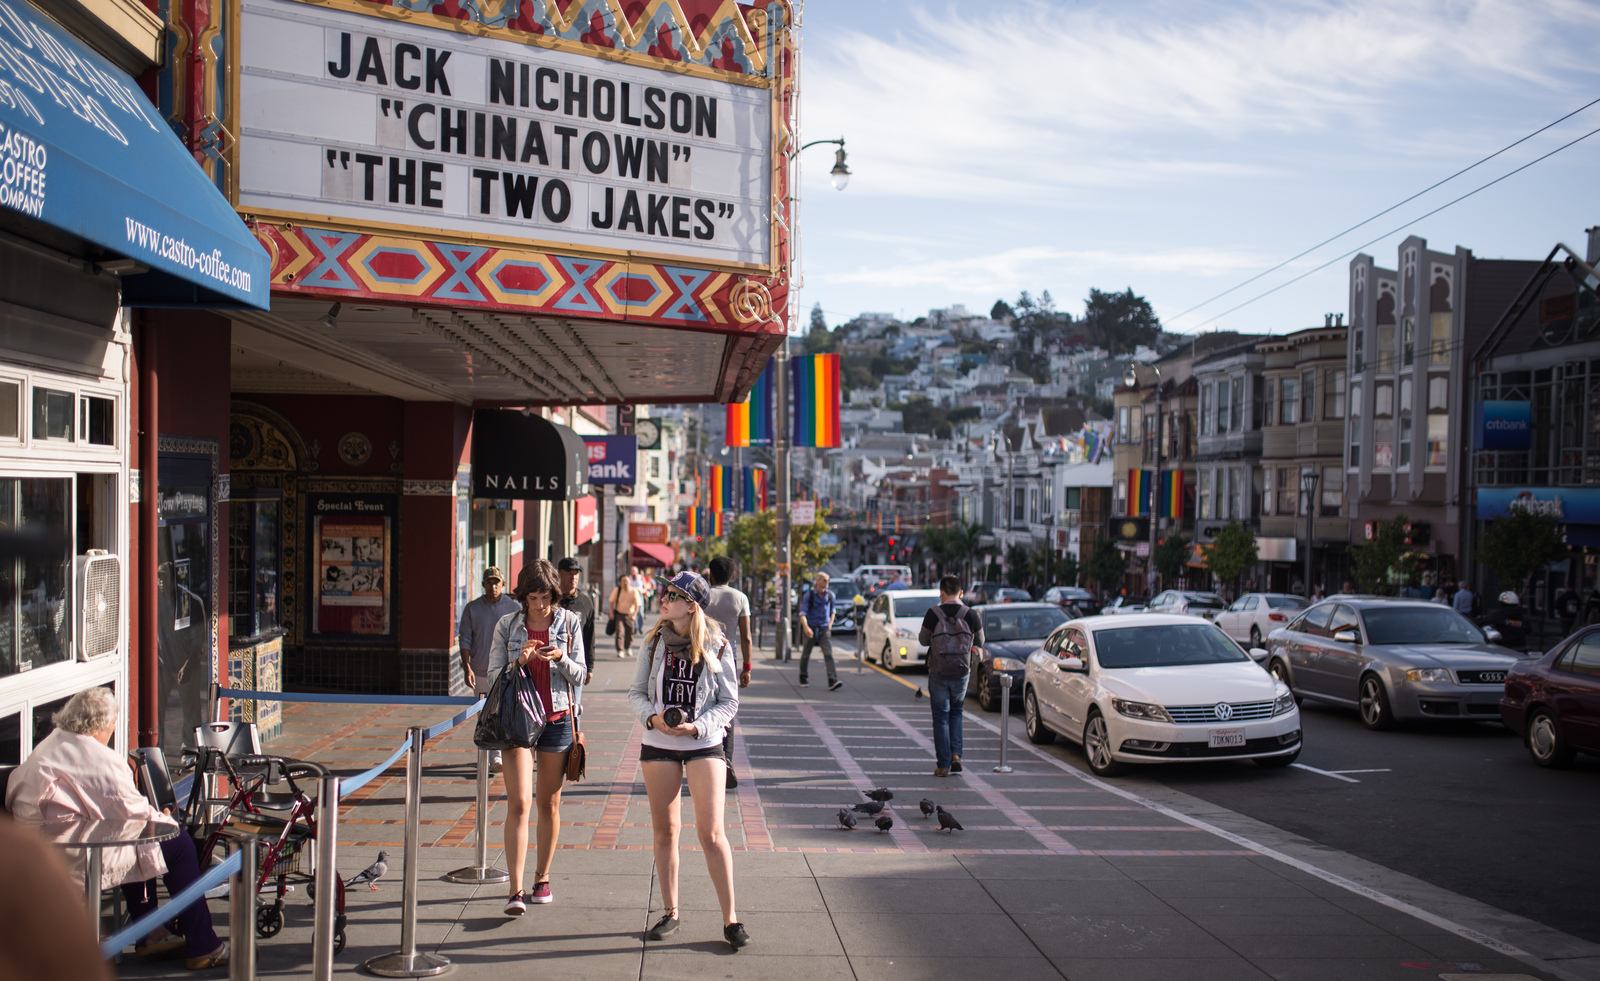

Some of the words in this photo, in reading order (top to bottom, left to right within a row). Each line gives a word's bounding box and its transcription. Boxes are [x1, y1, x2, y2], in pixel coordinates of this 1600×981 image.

[0, 2, 160, 133] OMPANY
[328, 32, 452, 96] JACK
[490, 58, 717, 139] NICHOLSON
[381, 98, 691, 184] "CHINATOWN"
[0, 155, 46, 199] OFFEE
[327, 149, 444, 208] "THE
[473, 168, 572, 223] TWO
[592, 187, 734, 240] JAKES"
[0, 184, 45, 219] OMPANY
[126, 217, 251, 293] www.castro-coffee.com
[1486, 419, 1527, 430] citibank
[485, 474, 559, 490] NAILS
[588, 460, 631, 479] ank
[317, 499, 352, 512] Special
[354, 499, 385, 511] Event
[679, 659, 694, 679] RI
[668, 683, 694, 702] YAY
